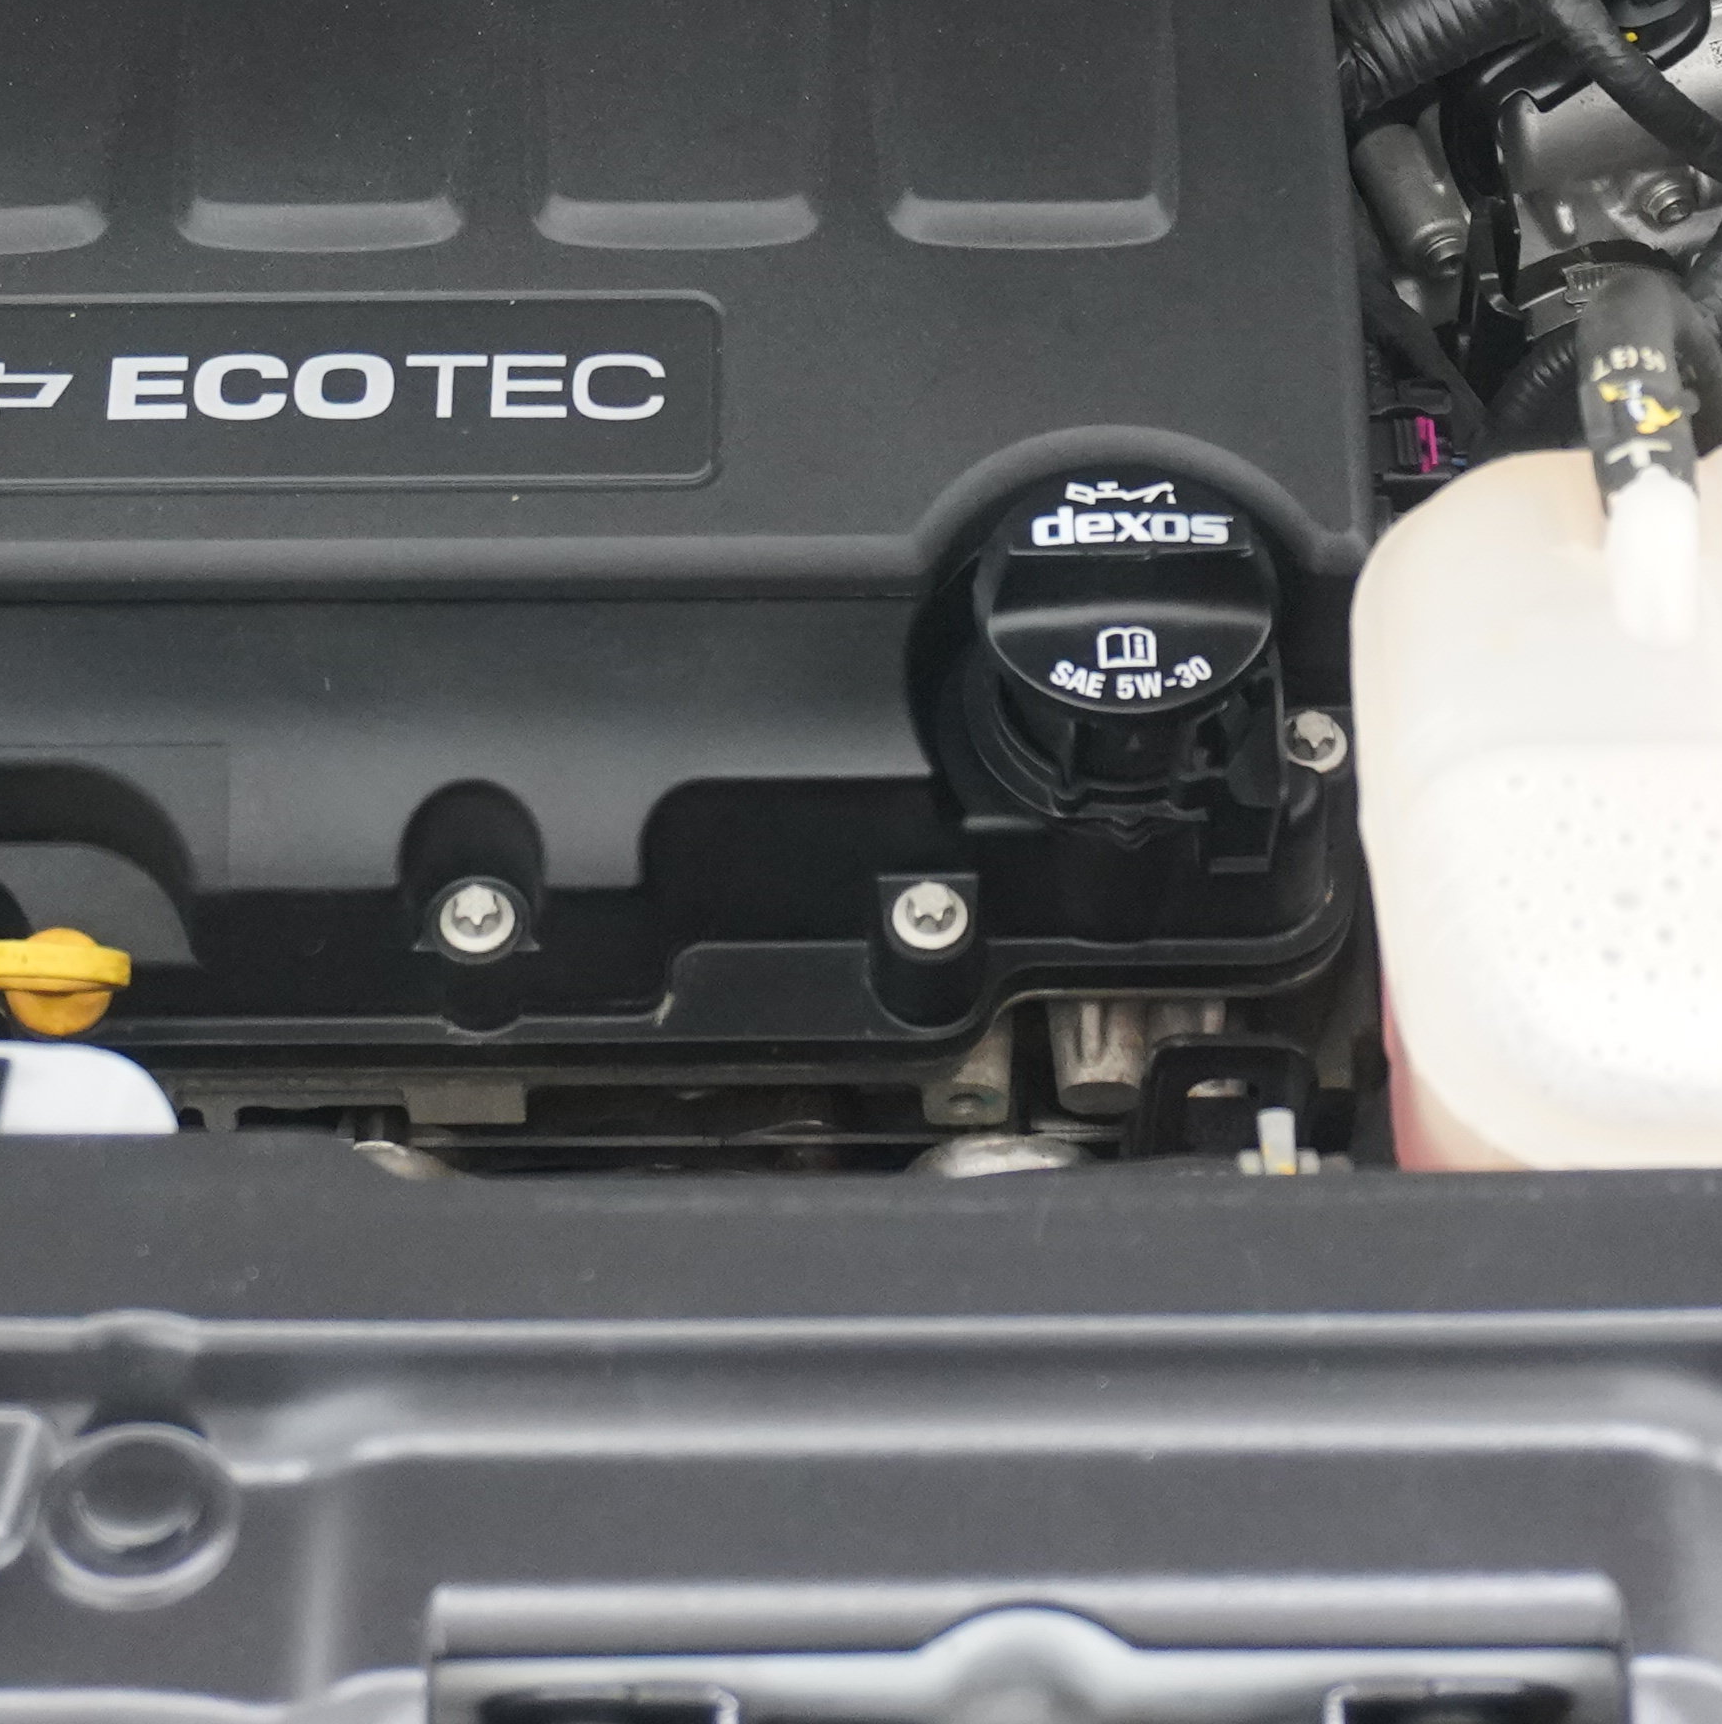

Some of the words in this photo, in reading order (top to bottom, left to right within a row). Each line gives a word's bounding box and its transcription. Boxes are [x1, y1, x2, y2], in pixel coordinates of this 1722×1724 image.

[105, 353, 666, 421] ECOTEC
[1031, 506, 1231, 547] dexos
[1049, 660, 1107, 700] SAE
[1116, 655, 1213, 701] 5W-30
